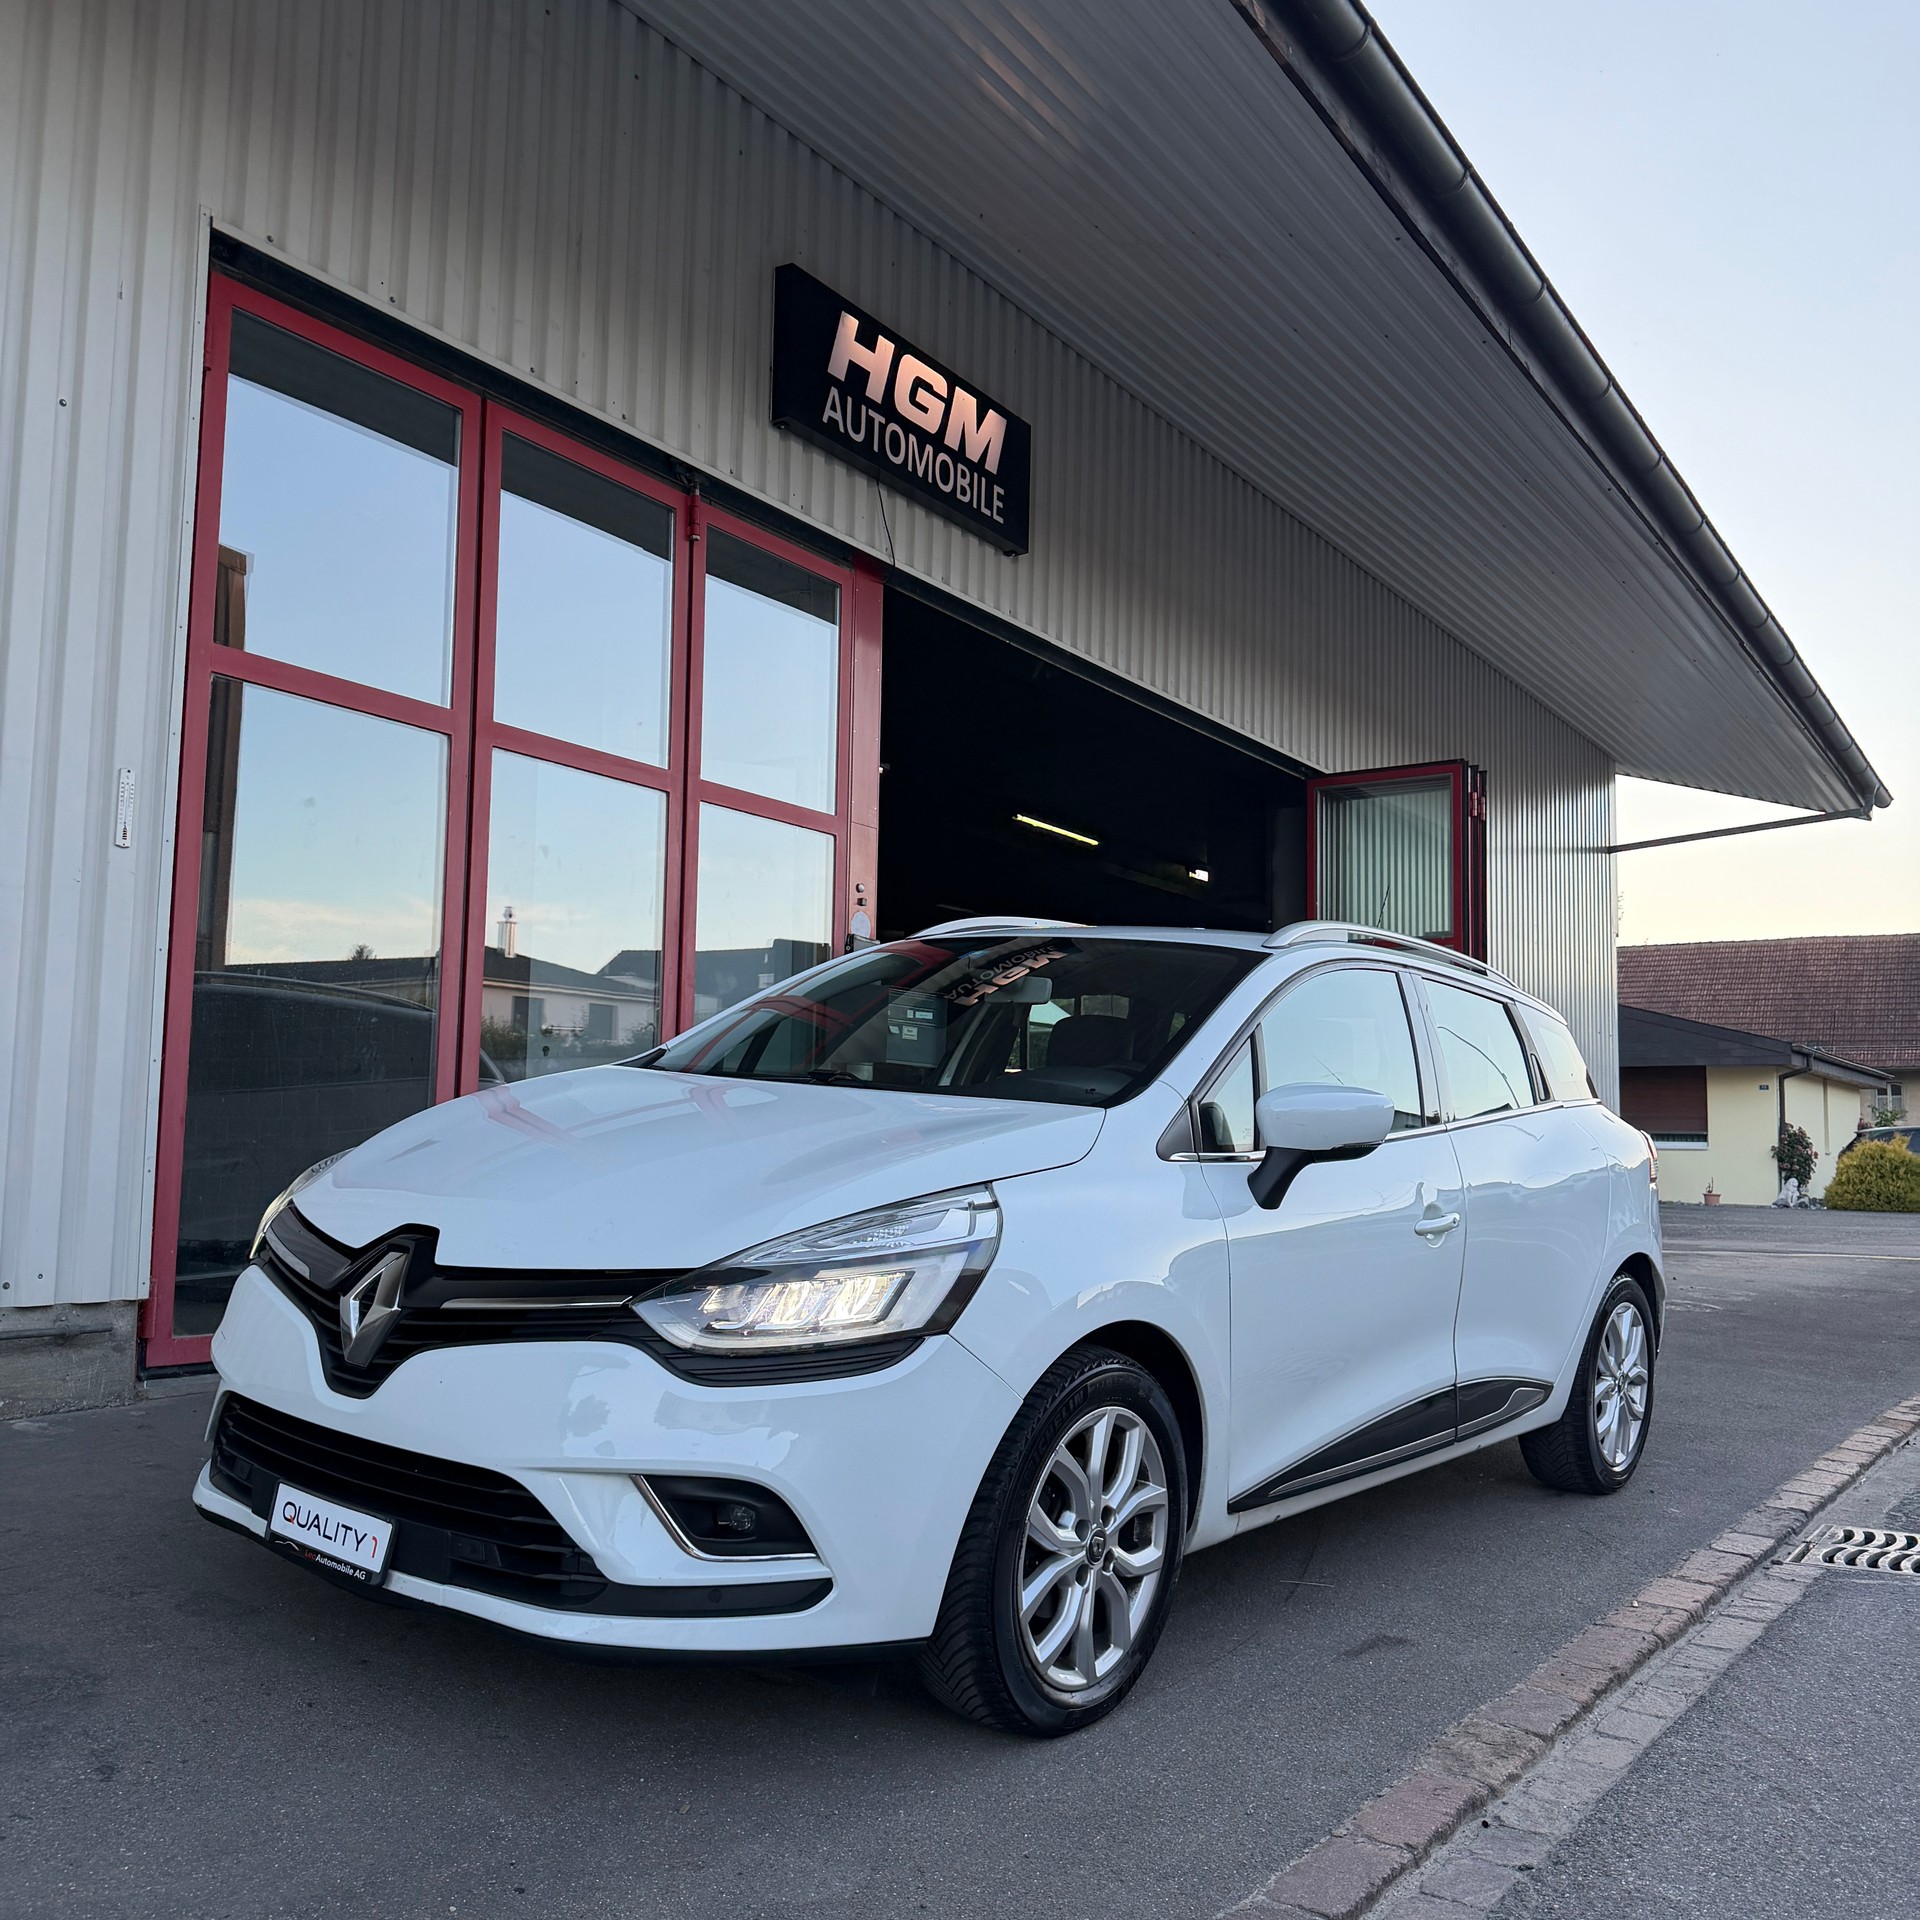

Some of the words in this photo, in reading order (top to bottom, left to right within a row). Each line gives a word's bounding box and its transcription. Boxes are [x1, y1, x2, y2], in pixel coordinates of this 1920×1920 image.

[827, 311, 1008, 475] HGM
[822, 386, 1005, 524] AUTOMOBILE
[282, 1501, 368, 1552] QUALITY
[371, 1535, 378, 1559] 1
[353, 1569, 366, 1580] AG
